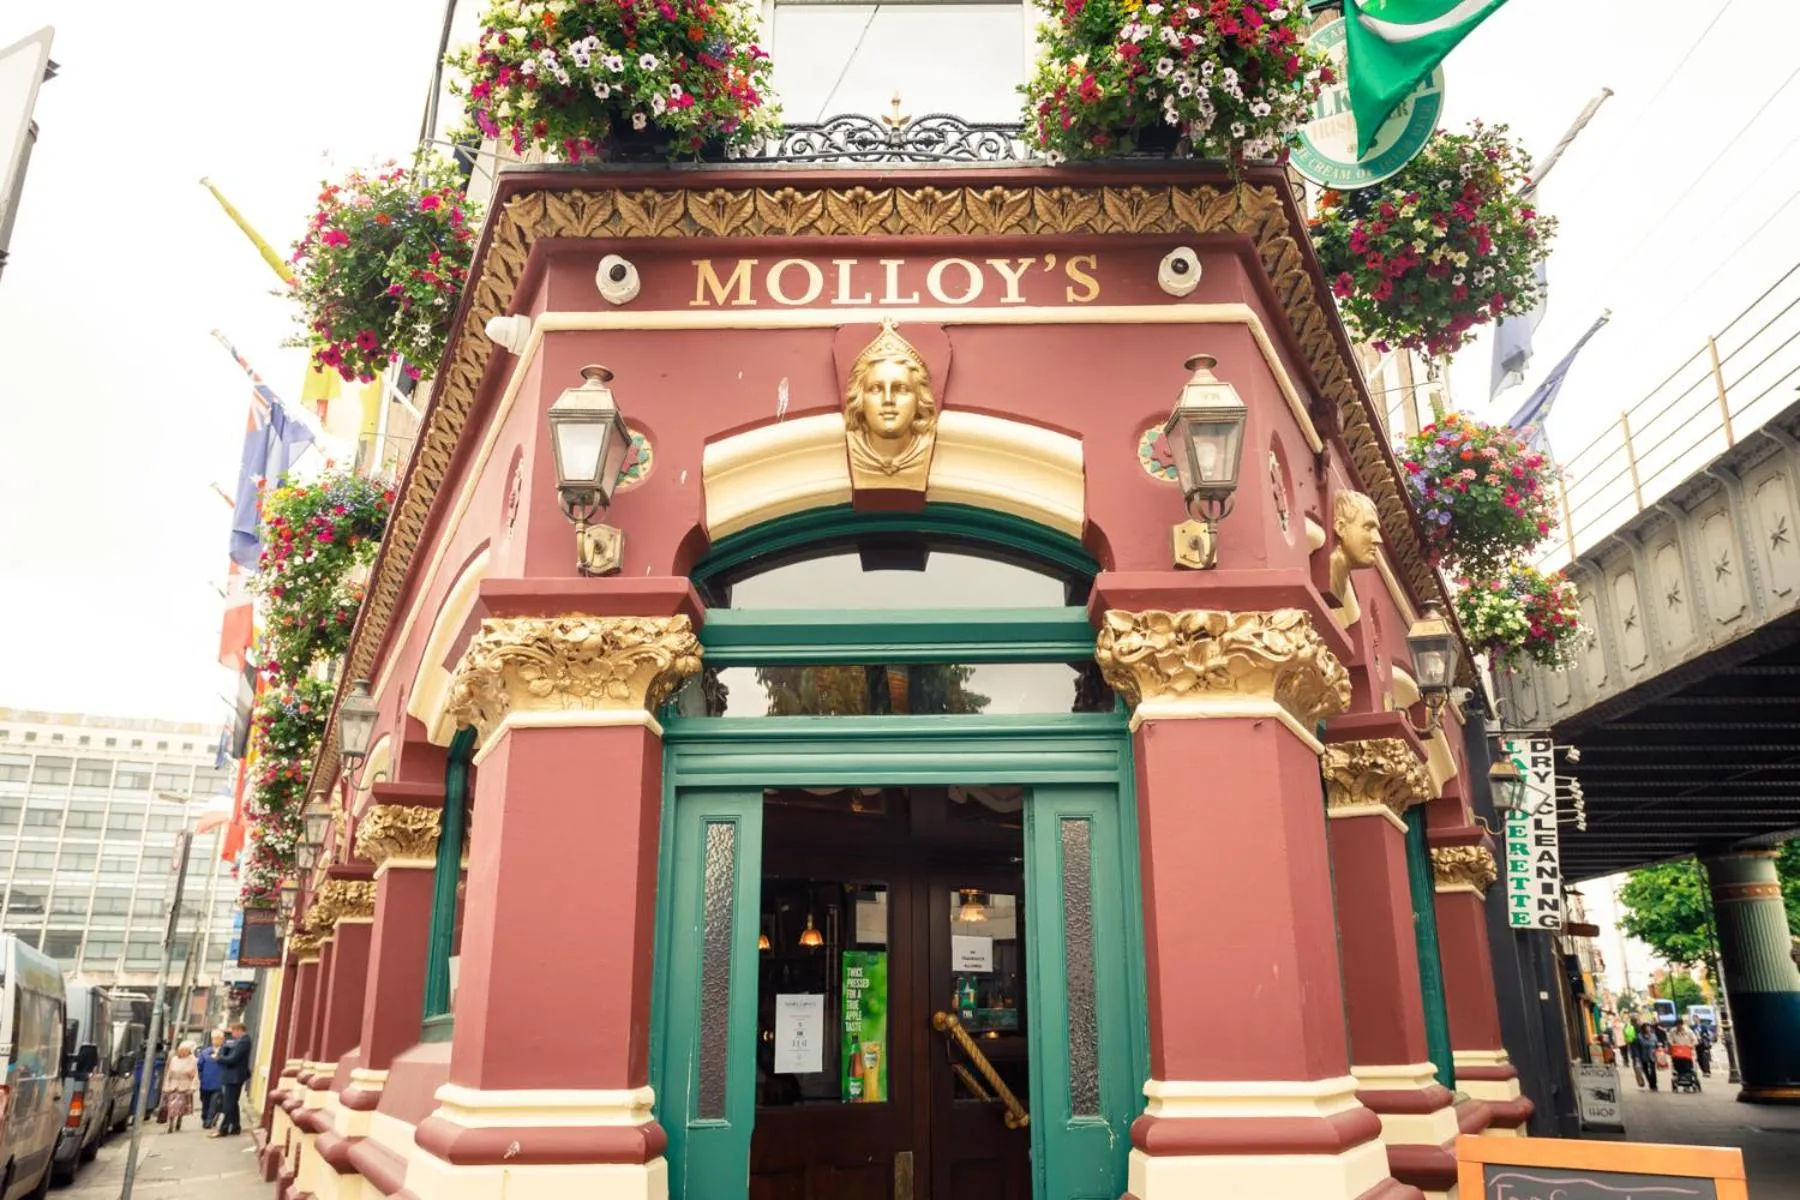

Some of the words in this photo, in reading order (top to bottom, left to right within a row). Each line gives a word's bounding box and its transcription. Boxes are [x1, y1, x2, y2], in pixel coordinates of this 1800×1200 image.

[689, 253, 1101, 306] MOLLOY'S
[1530, 741, 1552, 783] DRY
[1505, 741, 1532, 926] LADERETTE
[1533, 801, 1560, 929] CLEANING
